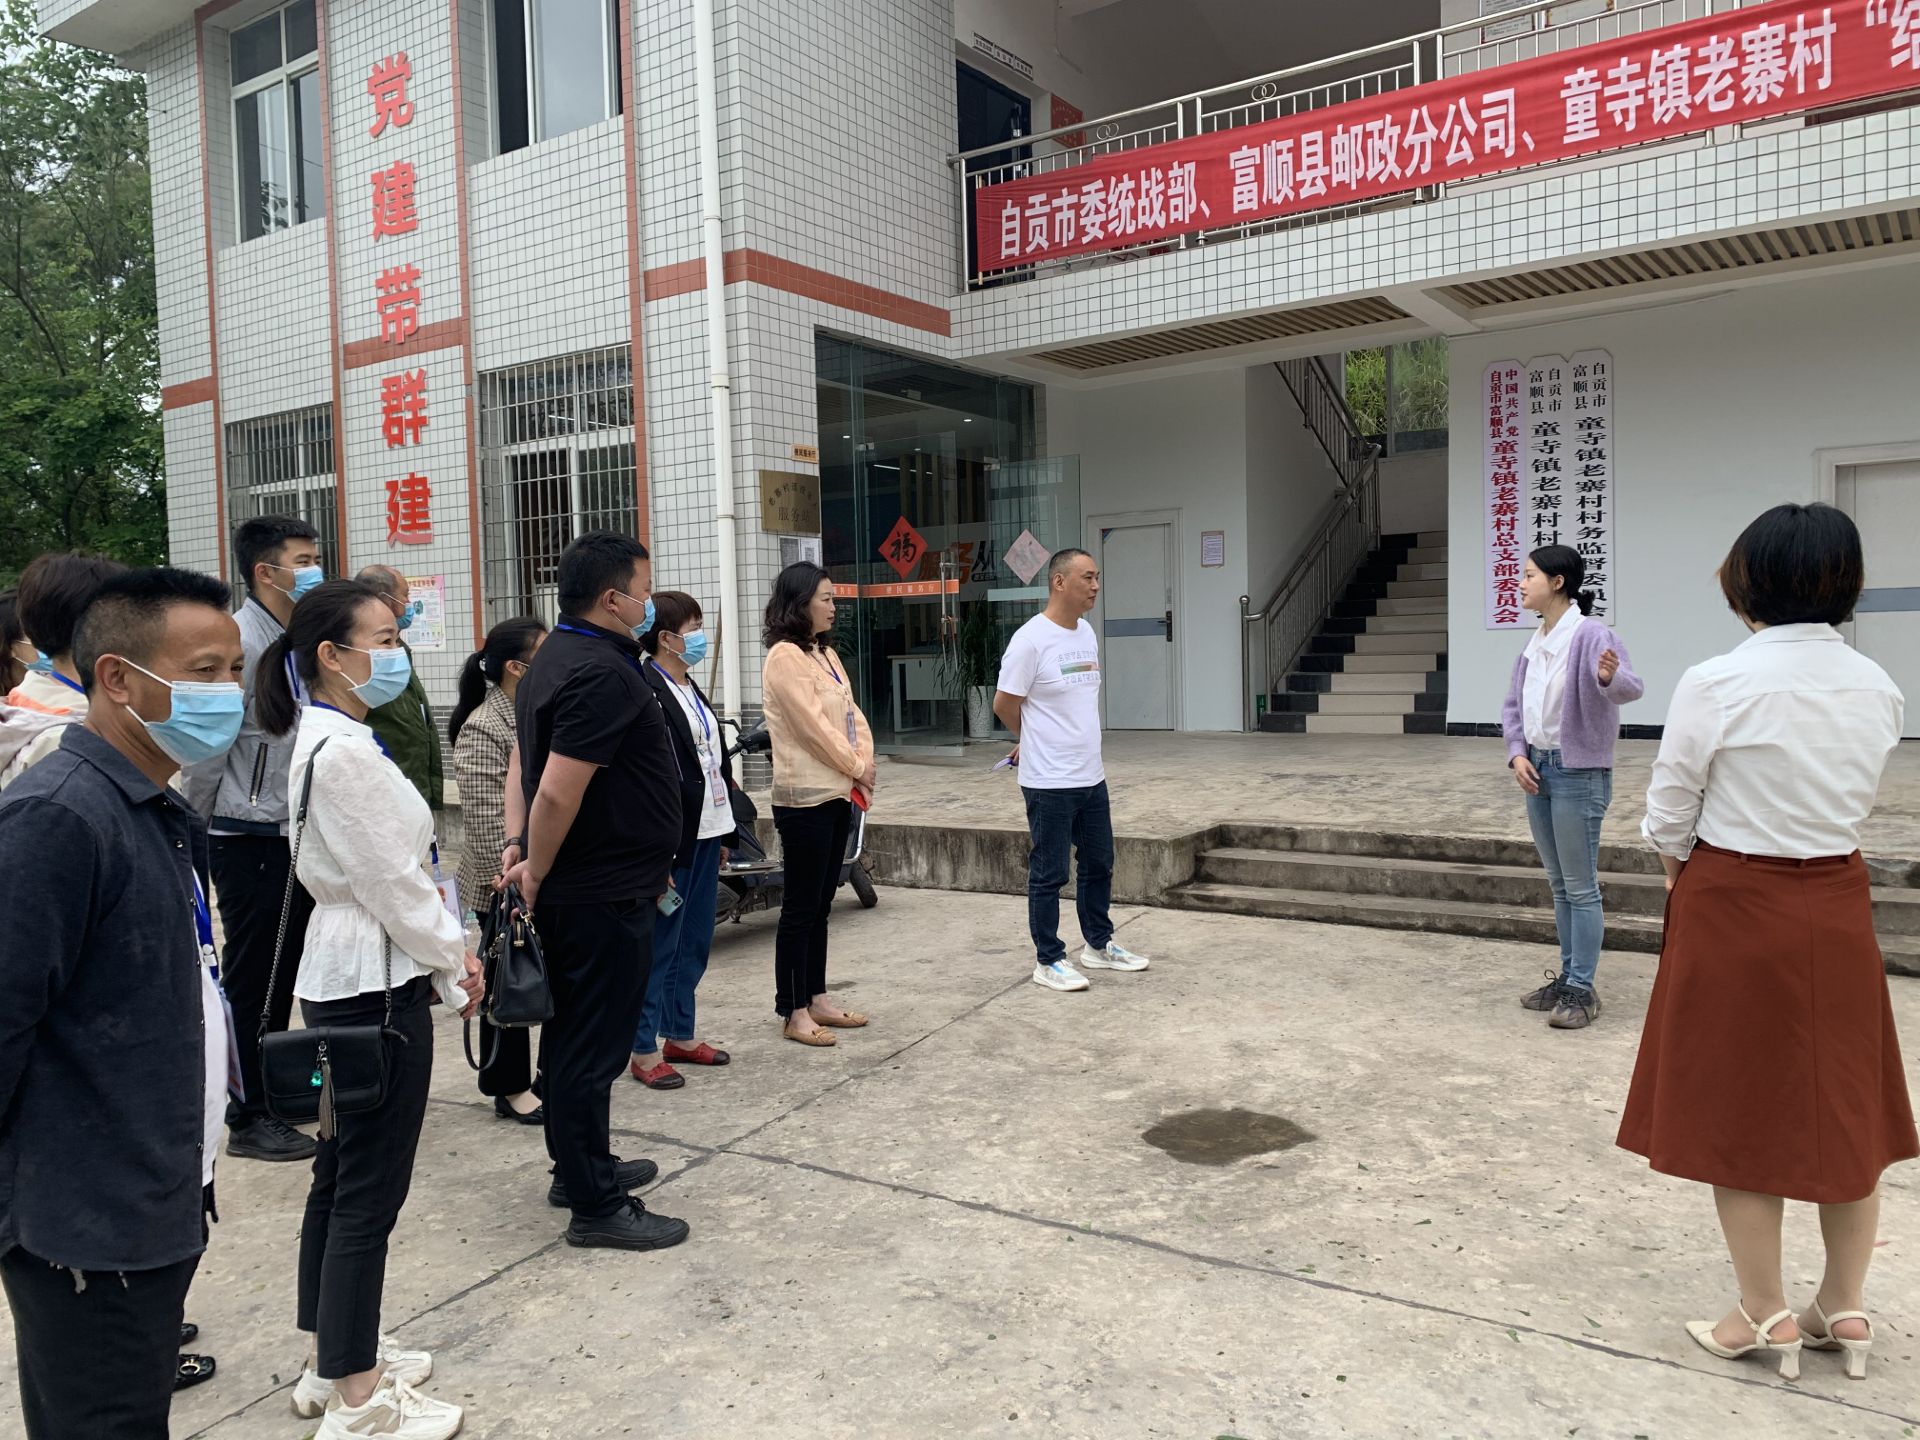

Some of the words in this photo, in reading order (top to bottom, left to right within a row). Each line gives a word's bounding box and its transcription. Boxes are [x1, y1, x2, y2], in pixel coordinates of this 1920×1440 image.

[367, 51, 434, 547] 党建带群建
[1490, 370, 1503, 438] 自贡市富顺县
[1505, 369, 1520, 437] 中国共产党
[1529, 370, 1545, 414] 富顺县
[1548, 368, 1562, 412] 自贡市
[1573, 365, 1589, 409] 富顺县
[1592, 362, 1607, 408] 自贡市
[891, 531, 917, 564] 福
[1490, 440, 1520, 624] 童寺镇老寨村总支部委员会
